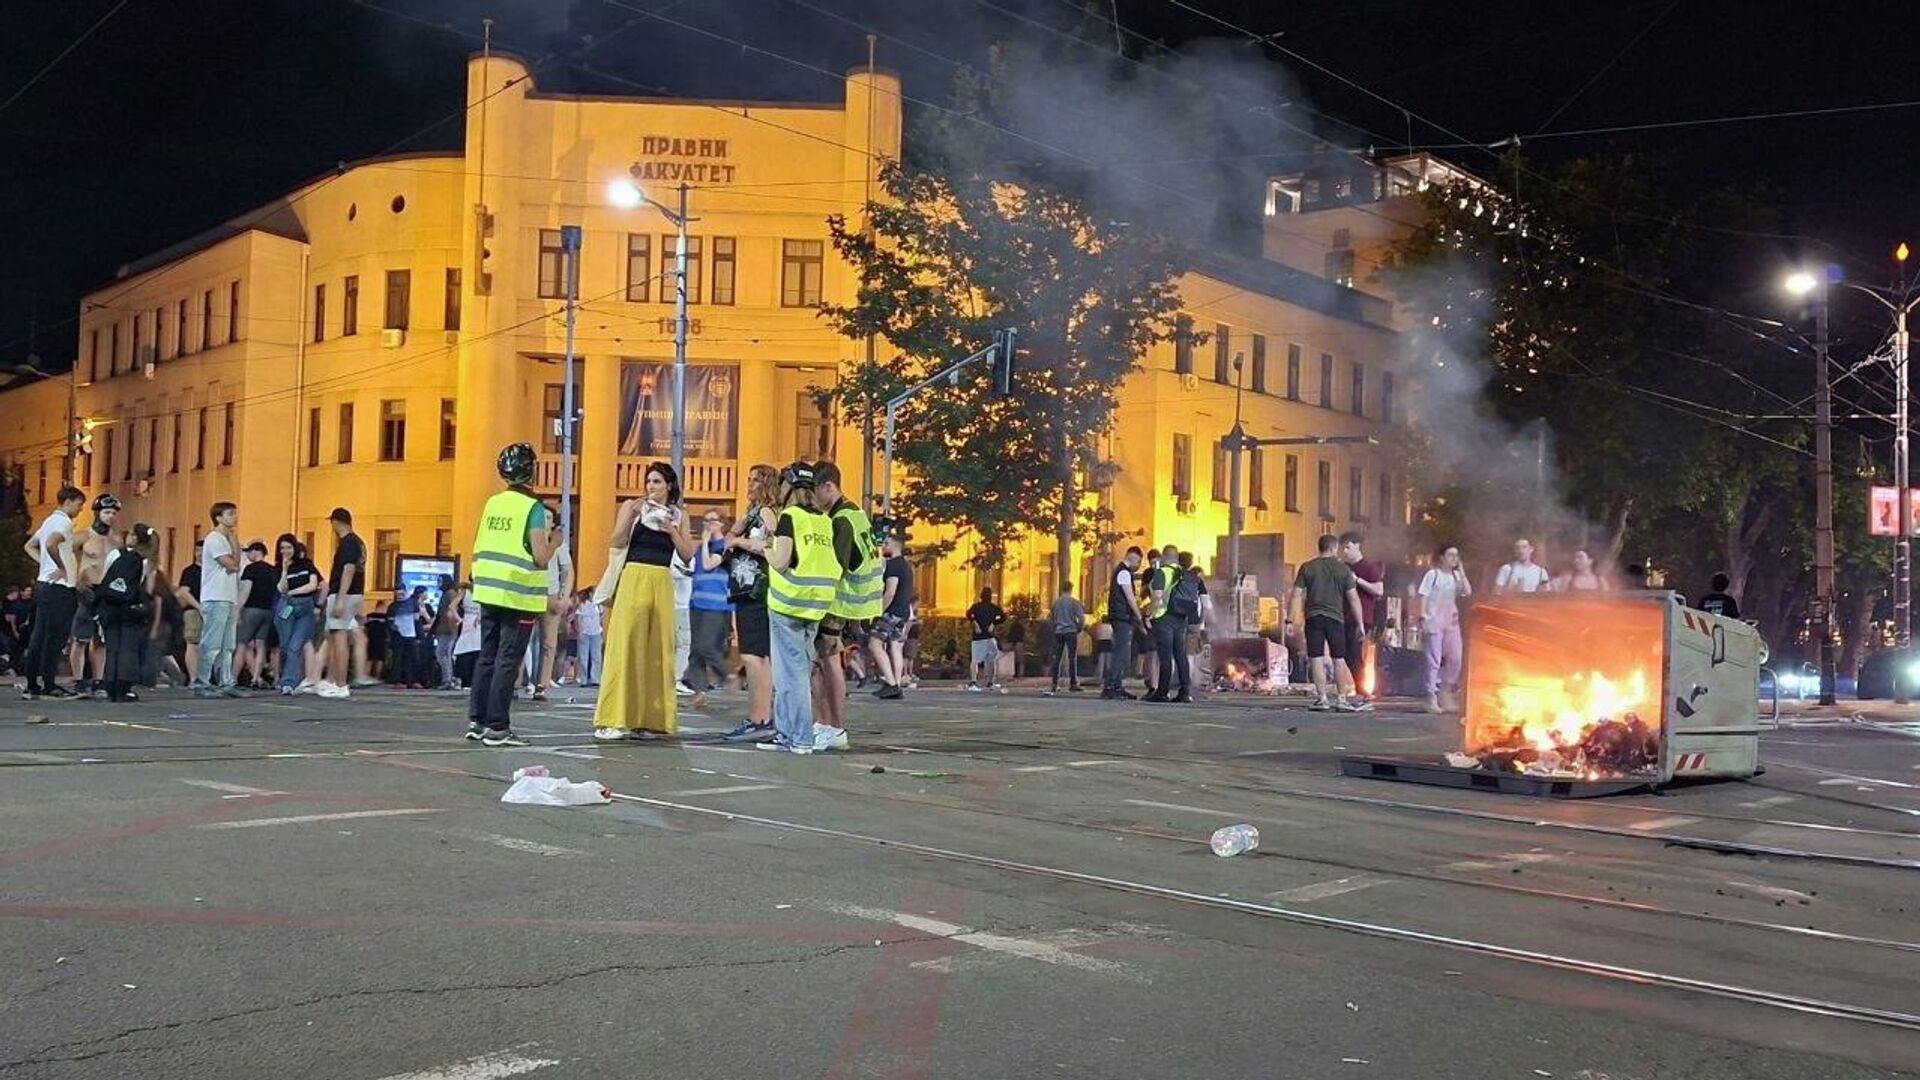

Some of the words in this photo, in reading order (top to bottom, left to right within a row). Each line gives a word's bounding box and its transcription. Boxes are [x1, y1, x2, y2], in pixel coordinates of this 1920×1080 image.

[642, 136, 728, 158] ПРАВНИ
[629, 161, 736, 183] ФАКУЛТЕТ
[659, 317, 702, 335] 188
